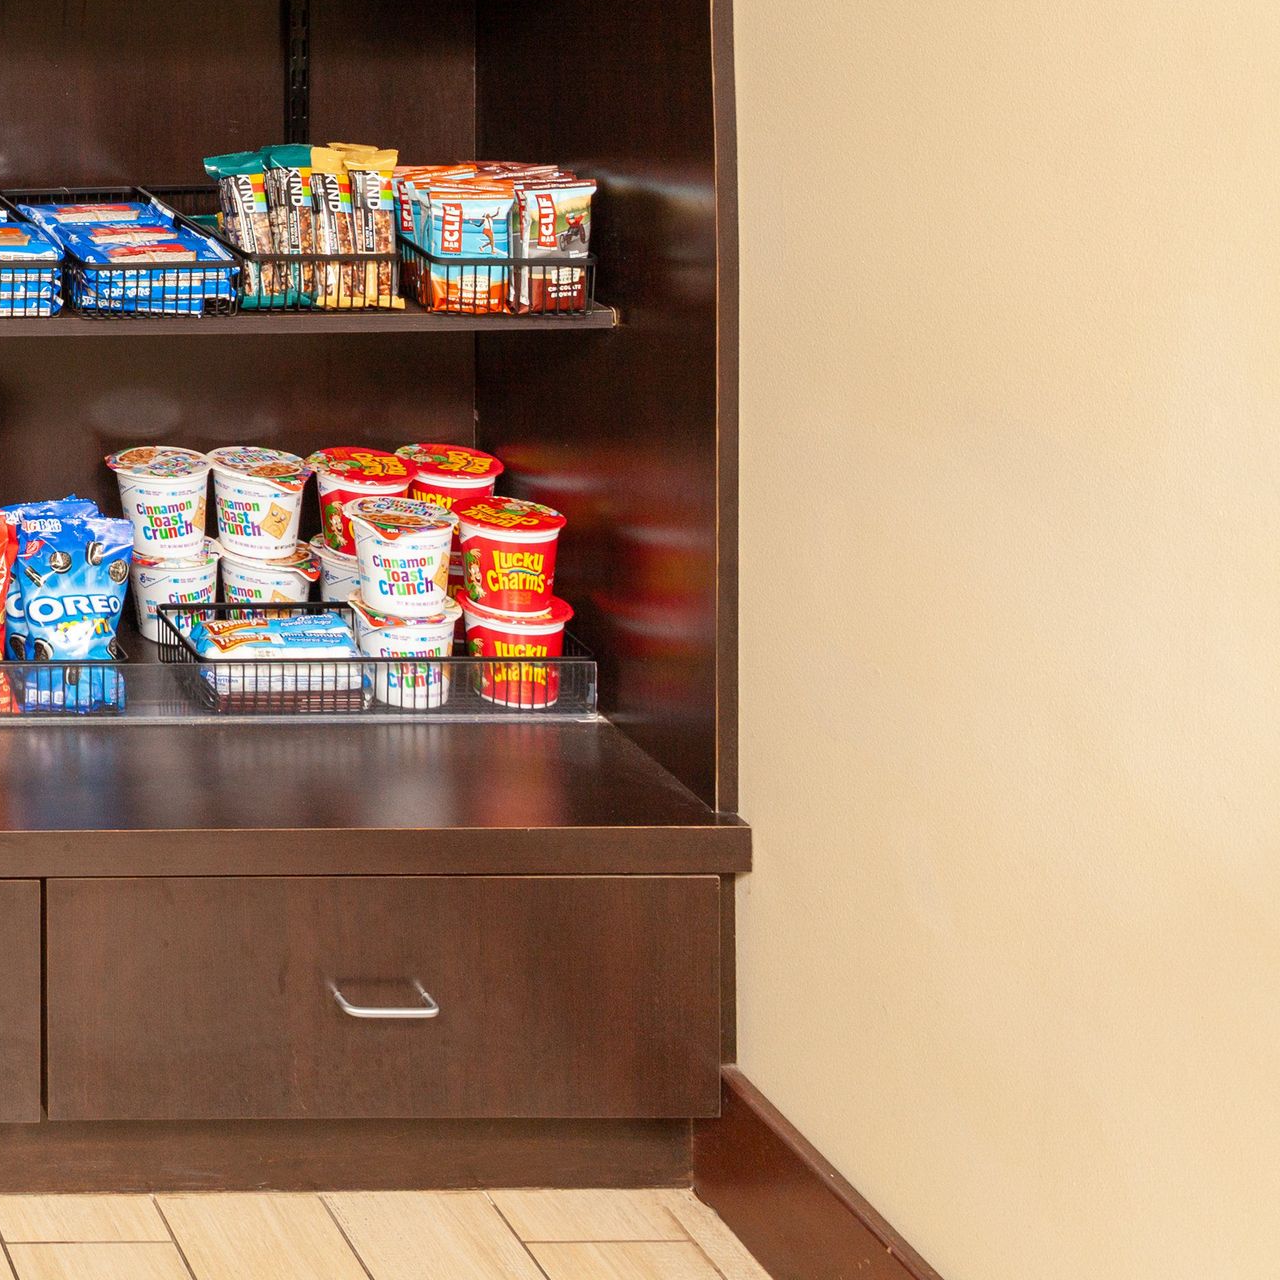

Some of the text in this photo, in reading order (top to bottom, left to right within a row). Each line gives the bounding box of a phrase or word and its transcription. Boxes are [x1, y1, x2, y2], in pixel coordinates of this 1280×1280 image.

[237, 174, 256, 213] KIND
[288, 167, 303, 207] KIND
[442, 203, 463, 240] CLIF
[443, 241, 459, 250] BAR
[136, 500, 192, 517] Cinnamon
[143, 521, 193, 541] Crunch
[149, 514, 183, 529] Toast
[372, 554, 434, 568] Cinnamon
[378, 578, 434, 596] Crunch
[487, 569, 545, 594] Charms
[28, 594, 121, 618] OREO
